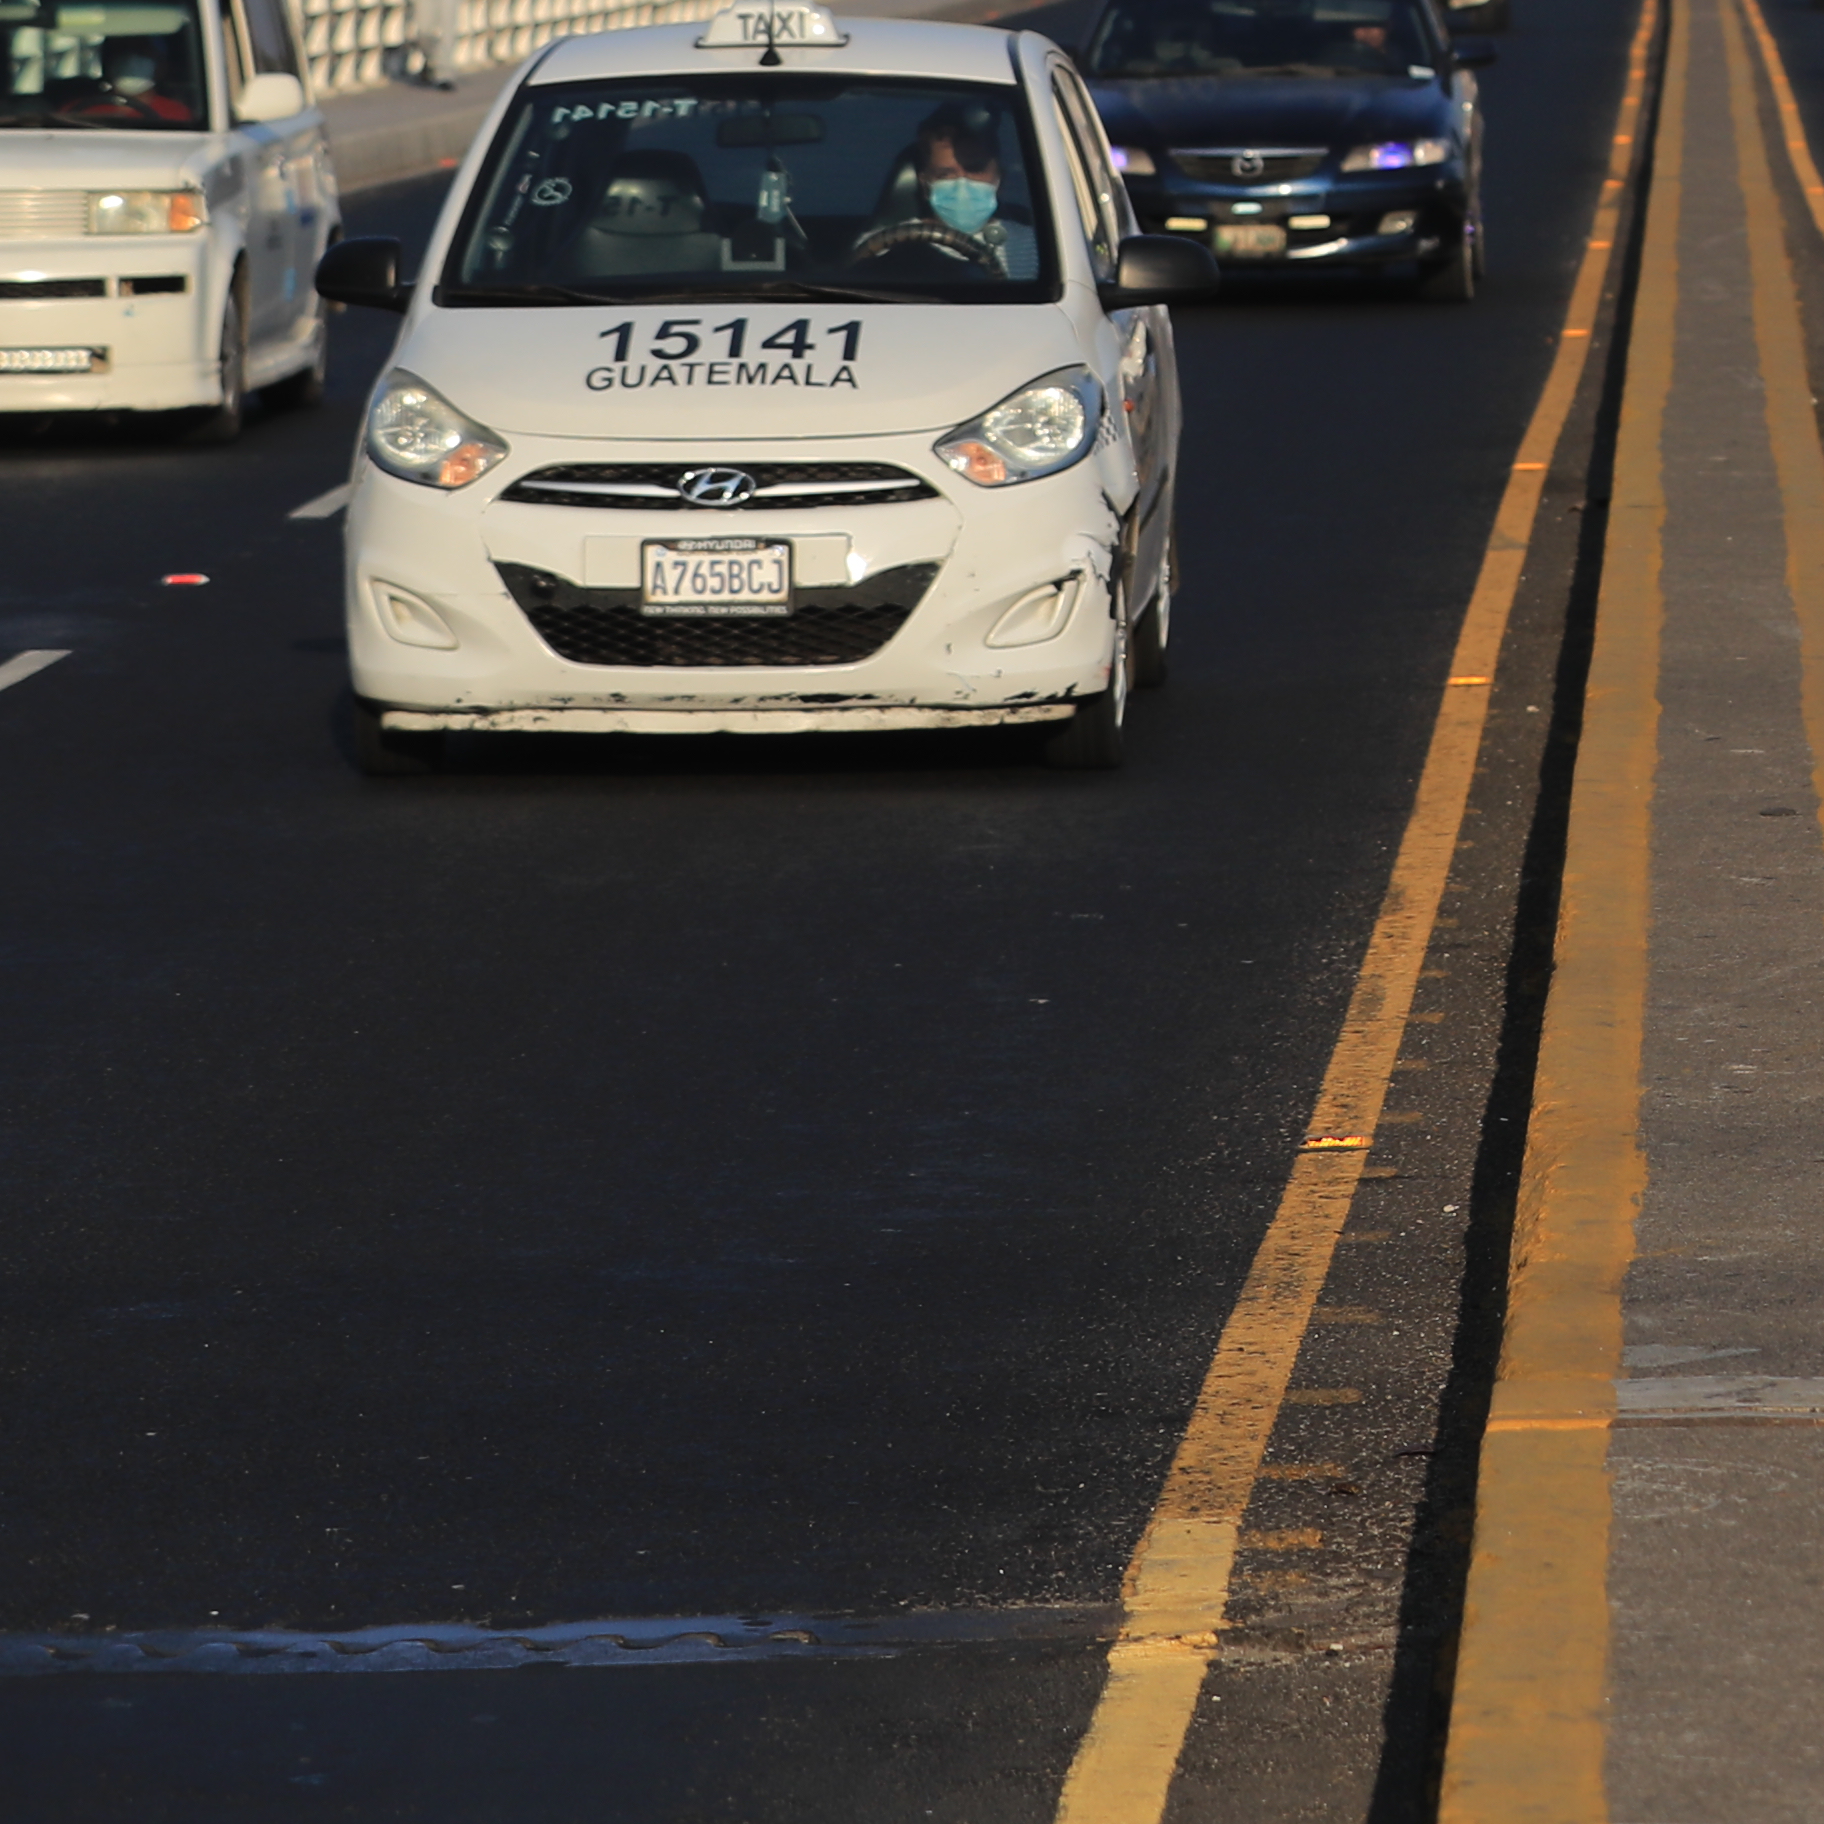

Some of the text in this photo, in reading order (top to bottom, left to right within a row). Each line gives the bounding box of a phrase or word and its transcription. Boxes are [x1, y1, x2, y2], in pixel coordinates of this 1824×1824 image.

[736, 10, 807, 40] TAXI
[599, 317, 862, 362] 15141
[585, 362, 859, 391] GUATEMALA
[700, 539, 756, 550] HYUNDAI
[651, 559, 785, 596] A765BCJ
